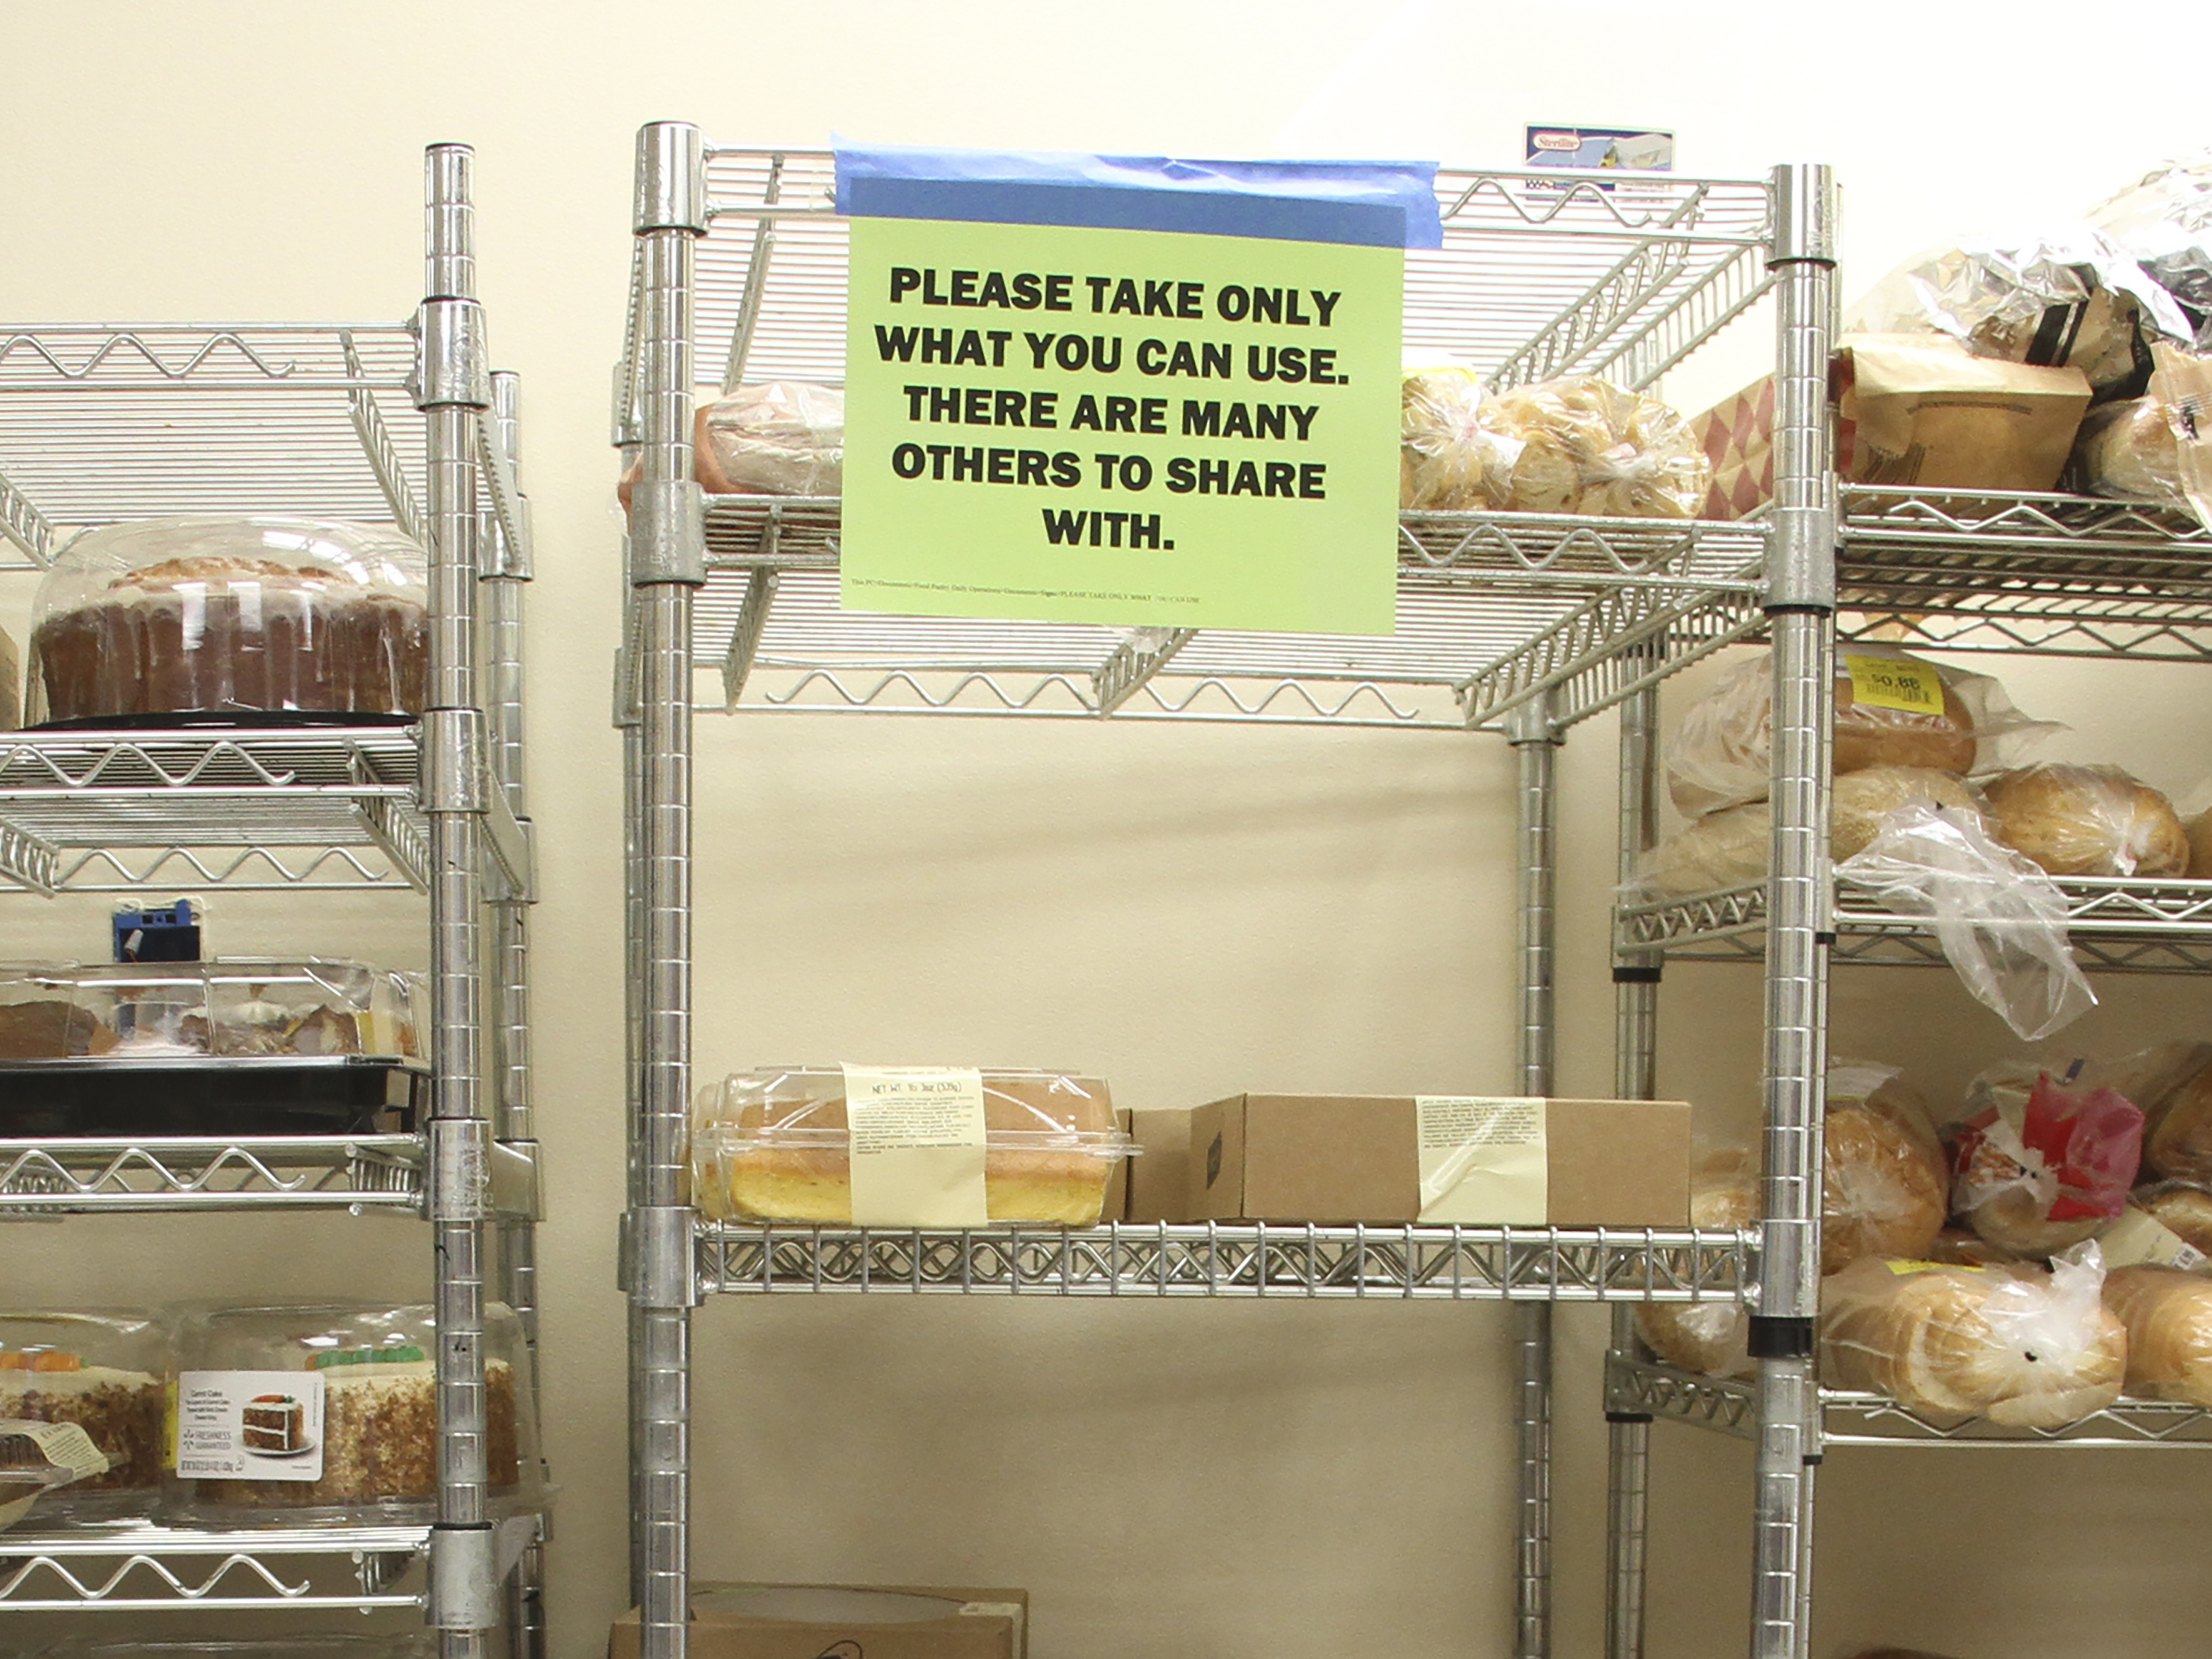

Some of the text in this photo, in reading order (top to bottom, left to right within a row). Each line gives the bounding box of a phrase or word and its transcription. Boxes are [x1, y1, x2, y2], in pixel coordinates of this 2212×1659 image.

[890, 267, 1341, 327] PLEASE TAKE ONLY
[874, 325, 1349, 385] WHAT YOU CAN USE.
[903, 385, 1319, 441] THERE ARE MANY
[892, 443, 1327, 500] OTHERS TO SHARE
[1042, 509, 1174, 551] WITH.
